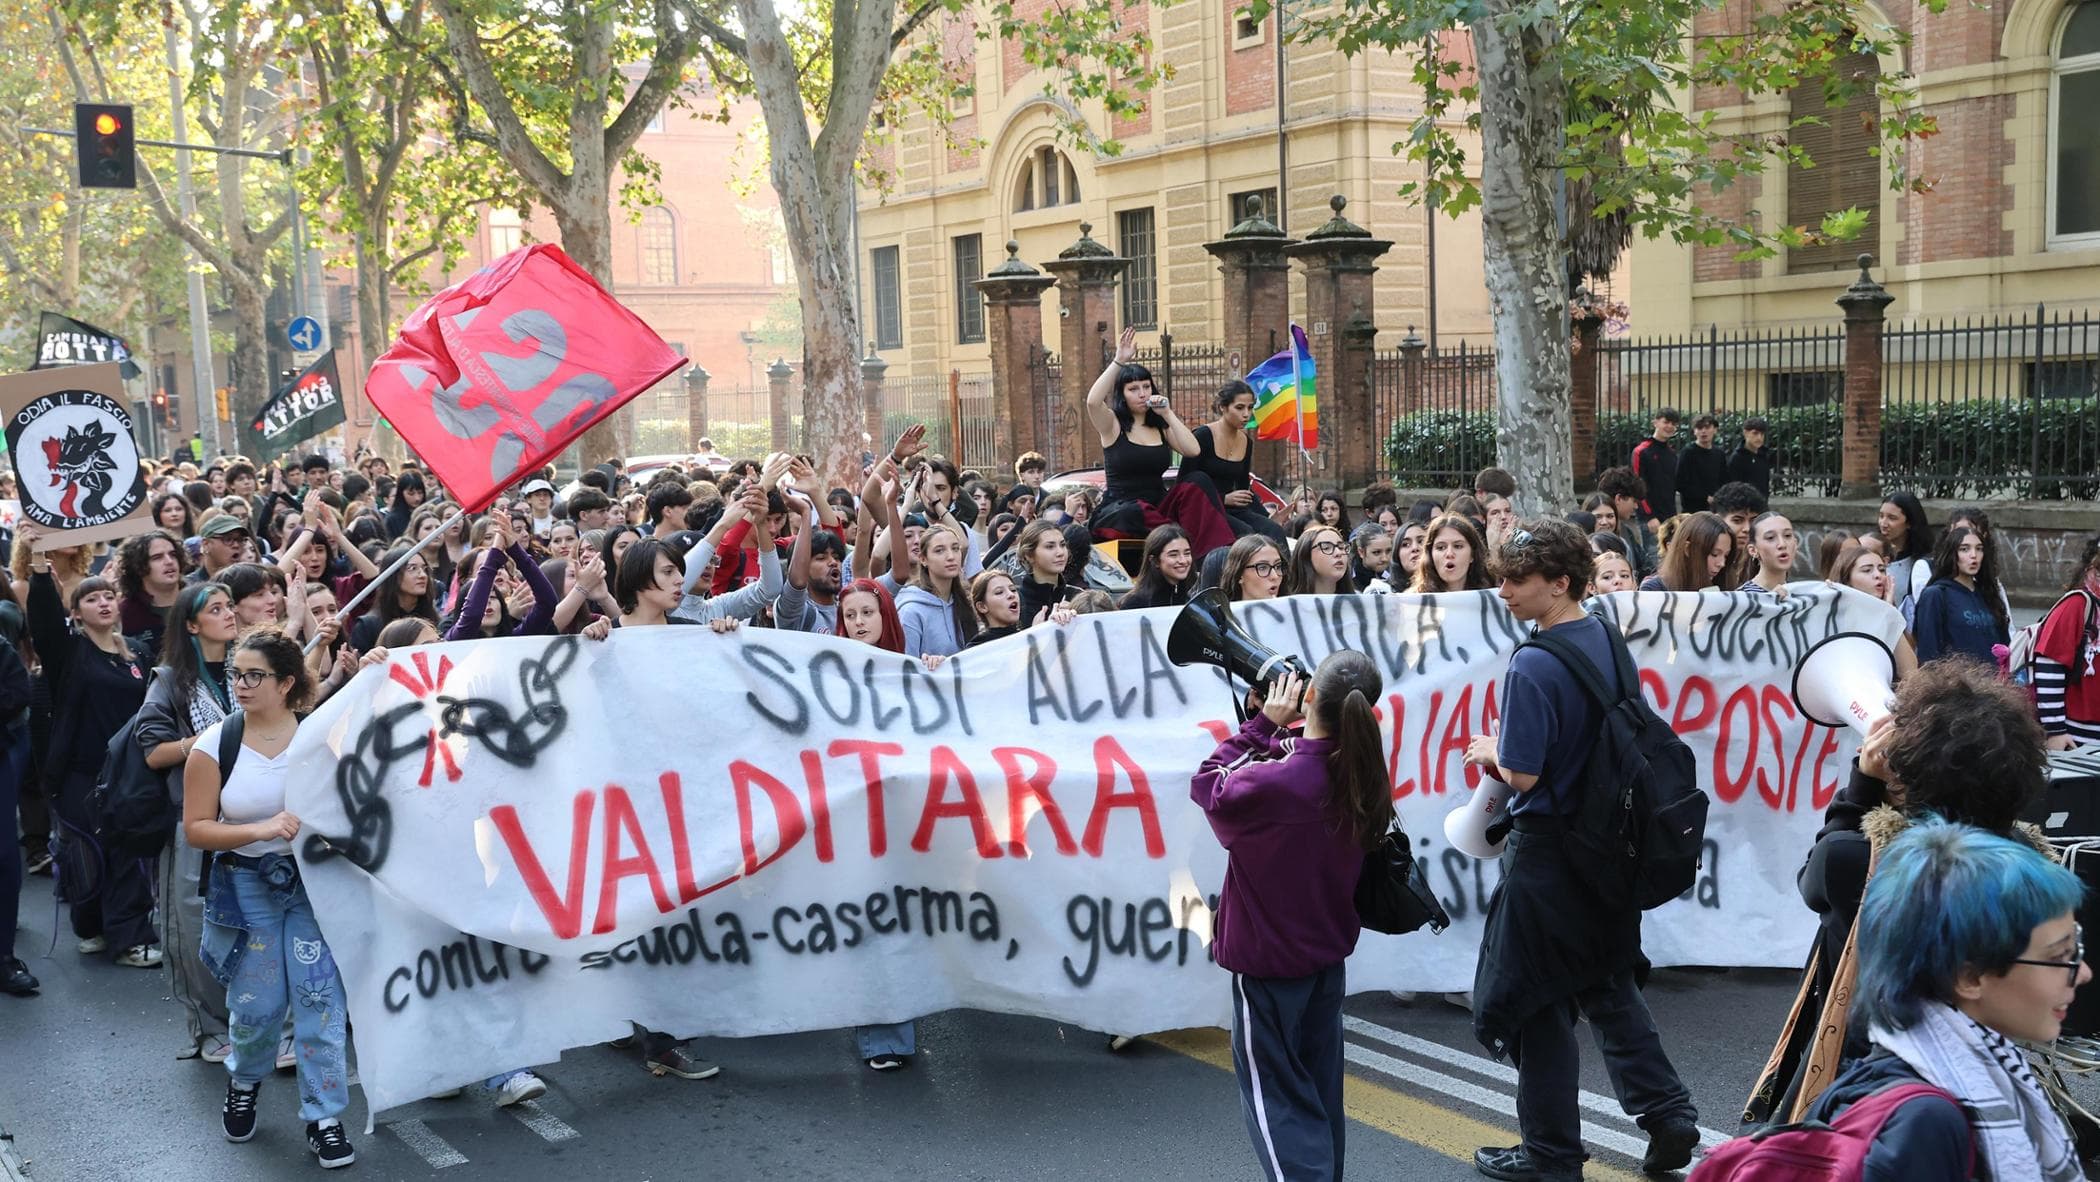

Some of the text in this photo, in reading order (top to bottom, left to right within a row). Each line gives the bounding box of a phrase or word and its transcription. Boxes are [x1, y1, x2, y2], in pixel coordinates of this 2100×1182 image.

[18, 393, 133, 429] ODIA IL FASCIO
[25, 493, 137, 528] AMA L'AMBIENTE
[1203, 647, 1224, 661] PYLE
[740, 643, 974, 736] SOLDI
[1026, 615, 1188, 726] ALLA
[1849, 700, 1869, 721] PYLE
[488, 735, 1167, 940] VALDITARA
